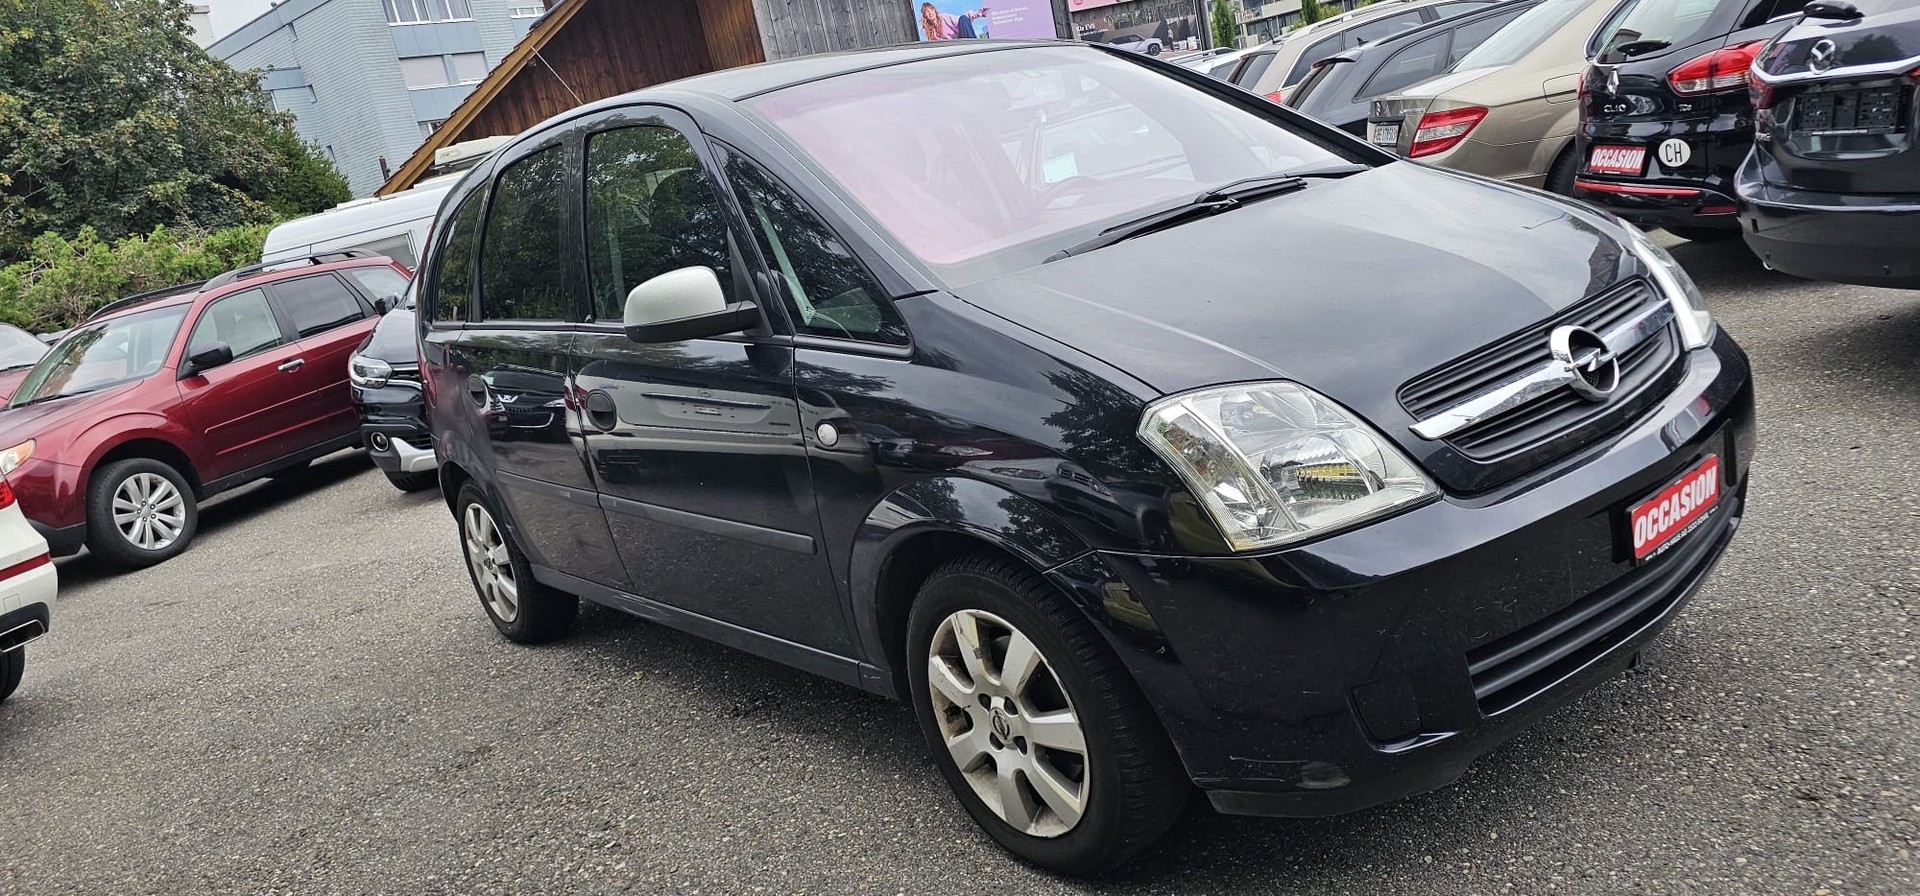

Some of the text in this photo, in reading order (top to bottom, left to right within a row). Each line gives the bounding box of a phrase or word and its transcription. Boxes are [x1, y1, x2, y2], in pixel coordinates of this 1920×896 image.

[1603, 103, 1627, 113] CLIO
[1590, 148, 1646, 169] OCCASION
[1665, 142, 1683, 163] CH
[1633, 464, 1718, 549] OCCASION
